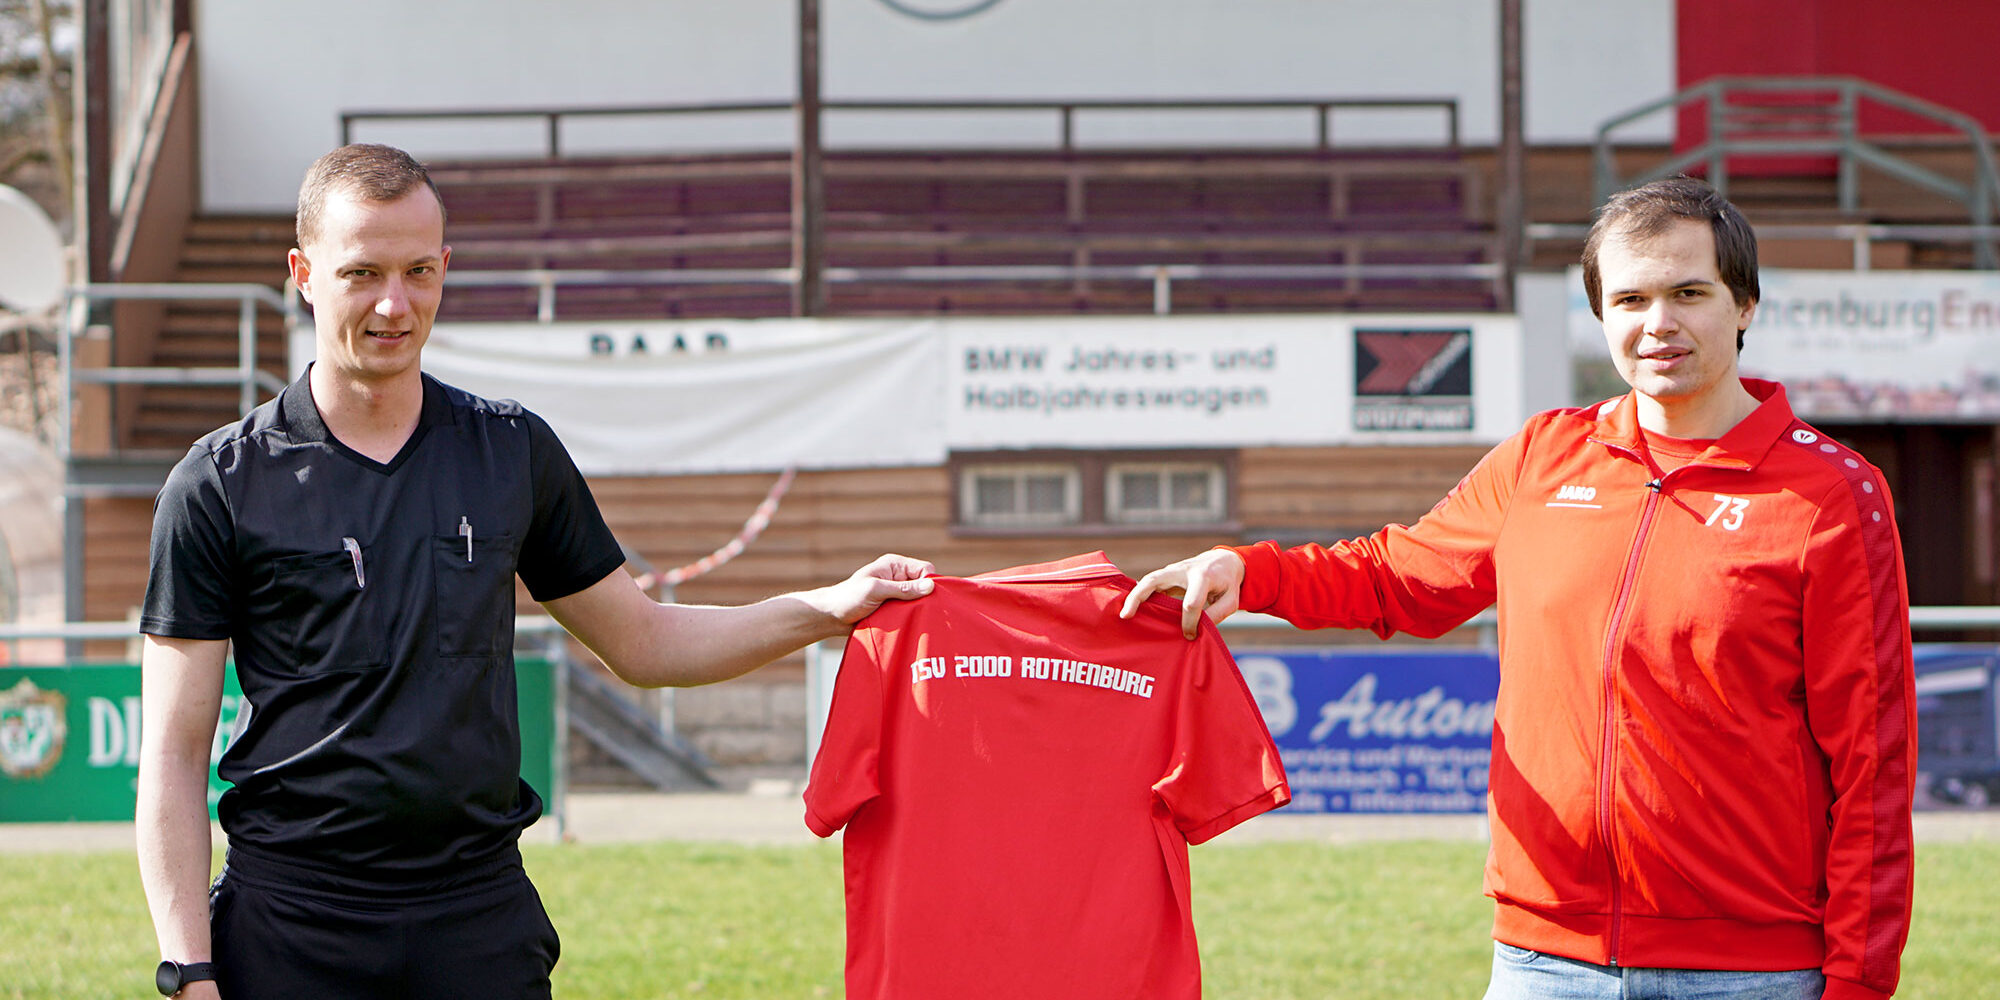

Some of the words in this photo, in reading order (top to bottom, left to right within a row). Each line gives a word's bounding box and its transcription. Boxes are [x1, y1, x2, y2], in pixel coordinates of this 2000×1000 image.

[964, 349, 1047, 371] BMW
[1213, 347, 1277, 371] und
[965, 385, 1268, 416] Halbjahreswagen
[1556, 485, 1597, 502] JAKO
[1705, 494, 1751, 532] 73
[954, 655, 1013, 678] 2000
[1021, 656, 1156, 699] ROTHENBURG
